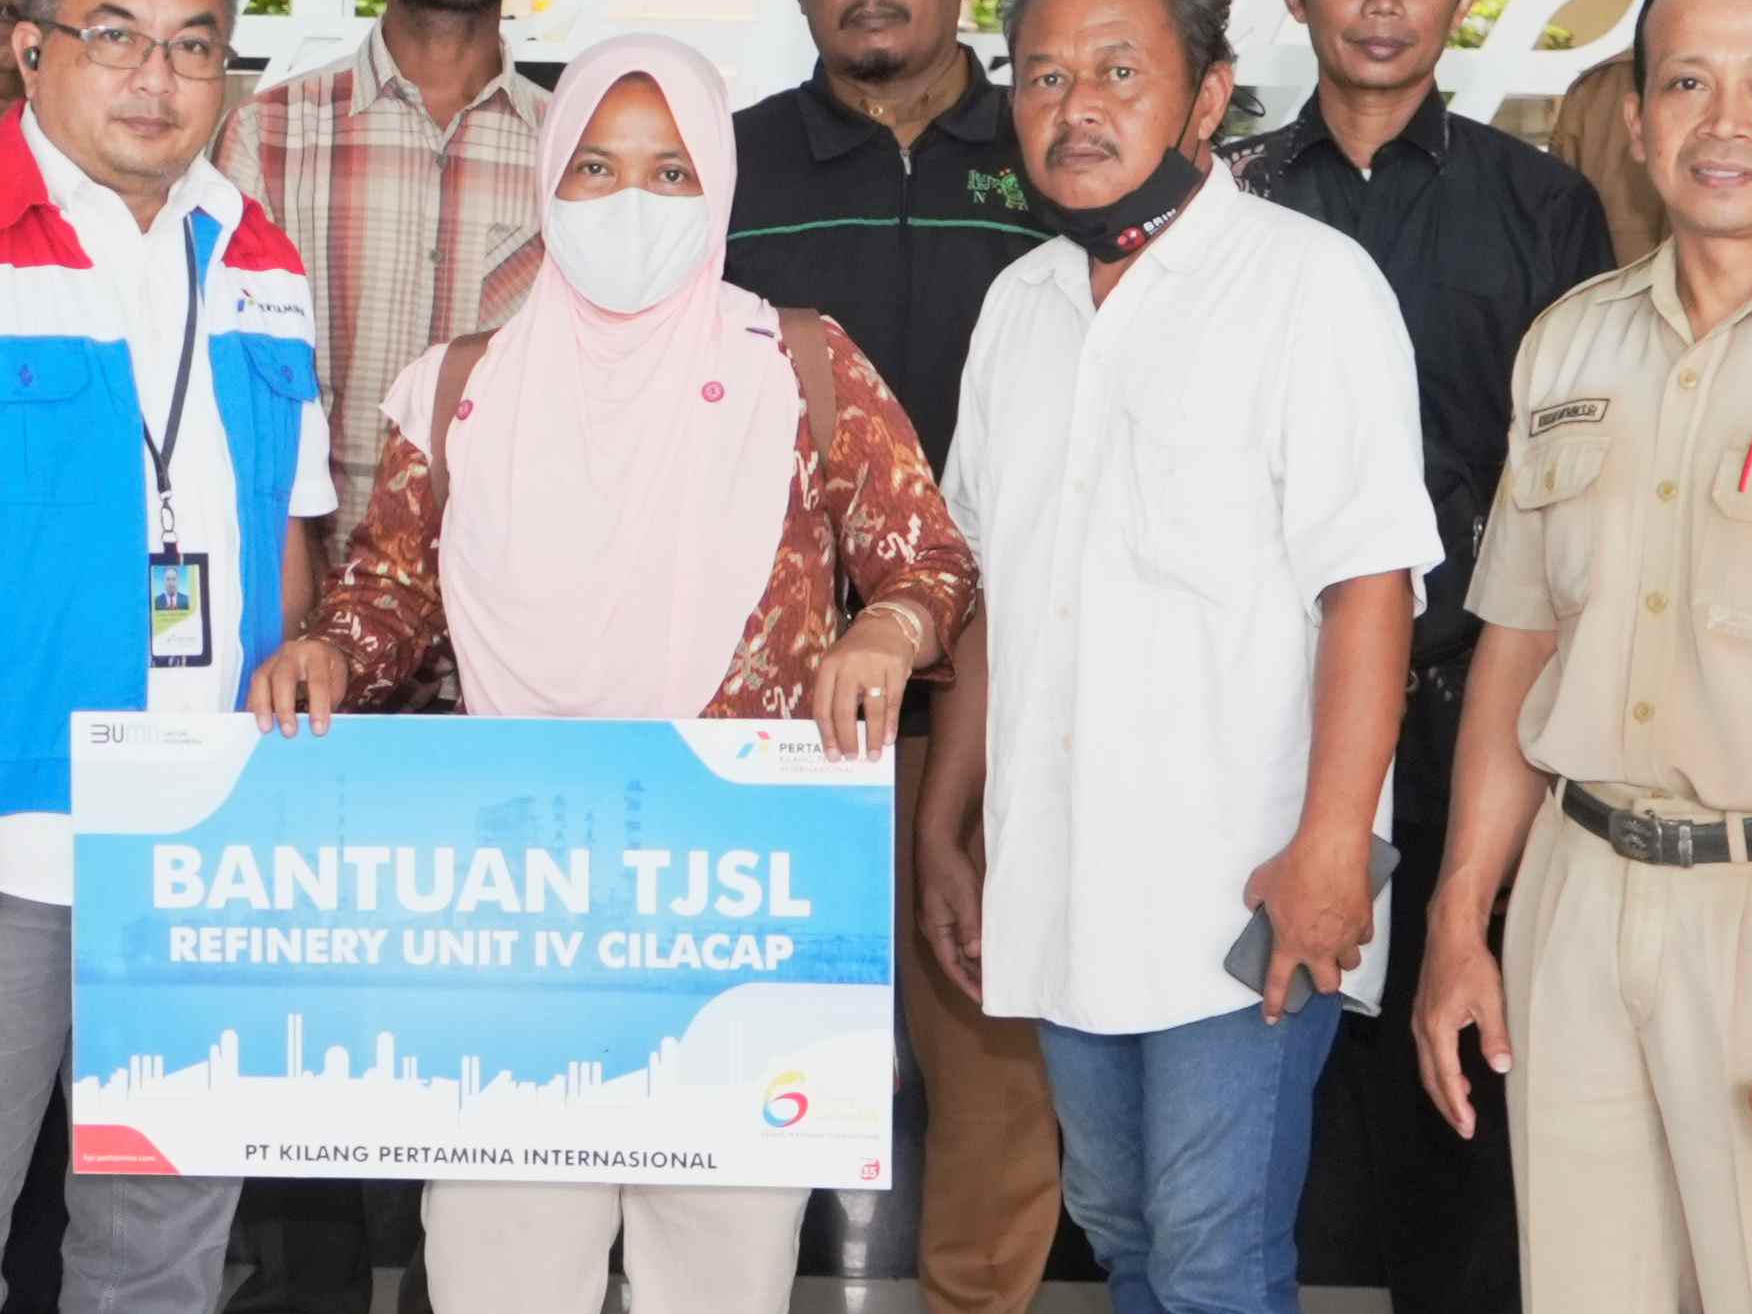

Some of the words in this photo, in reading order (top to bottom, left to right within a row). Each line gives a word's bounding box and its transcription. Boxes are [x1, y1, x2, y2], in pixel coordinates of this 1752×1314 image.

[152, 845, 590, 916] BANTUAN
[623, 850, 811, 918] TJSL
[170, 926, 389, 966] REFINERY
[403, 930, 520, 967] UNIT
[535, 933, 582, 968] IV
[597, 934, 794, 971] CILACAP
[246, 1144, 269, 1162] PT
[279, 1144, 369, 1165] KILANG
[379, 1146, 514, 1167] PERTAMINA
[524, 1148, 718, 1170] INTERNASIONAL
